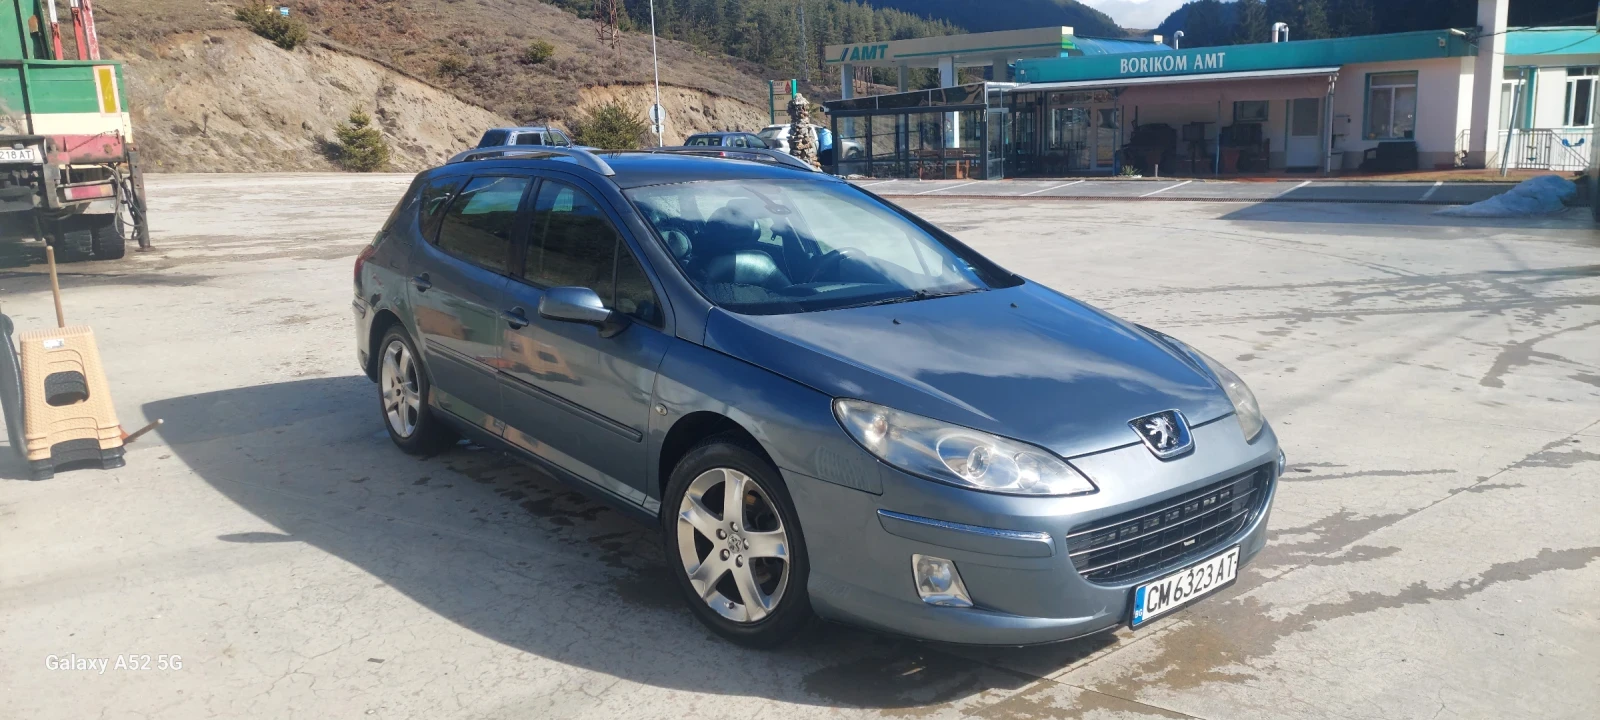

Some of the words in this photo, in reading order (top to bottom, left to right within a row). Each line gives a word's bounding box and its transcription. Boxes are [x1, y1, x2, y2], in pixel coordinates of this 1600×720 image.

[850, 44, 888, 61] AMT
[1120, 55, 1187, 74] BORIKOM
[1194, 52, 1225, 70] AMT
[20, 151, 31, 159] AT
[1146, 580, 1172, 613] CM
[1173, 563, 1213, 602] 6323
[1215, 551, 1236, 584] AT
[1134, 608, 1143, 619] BG
